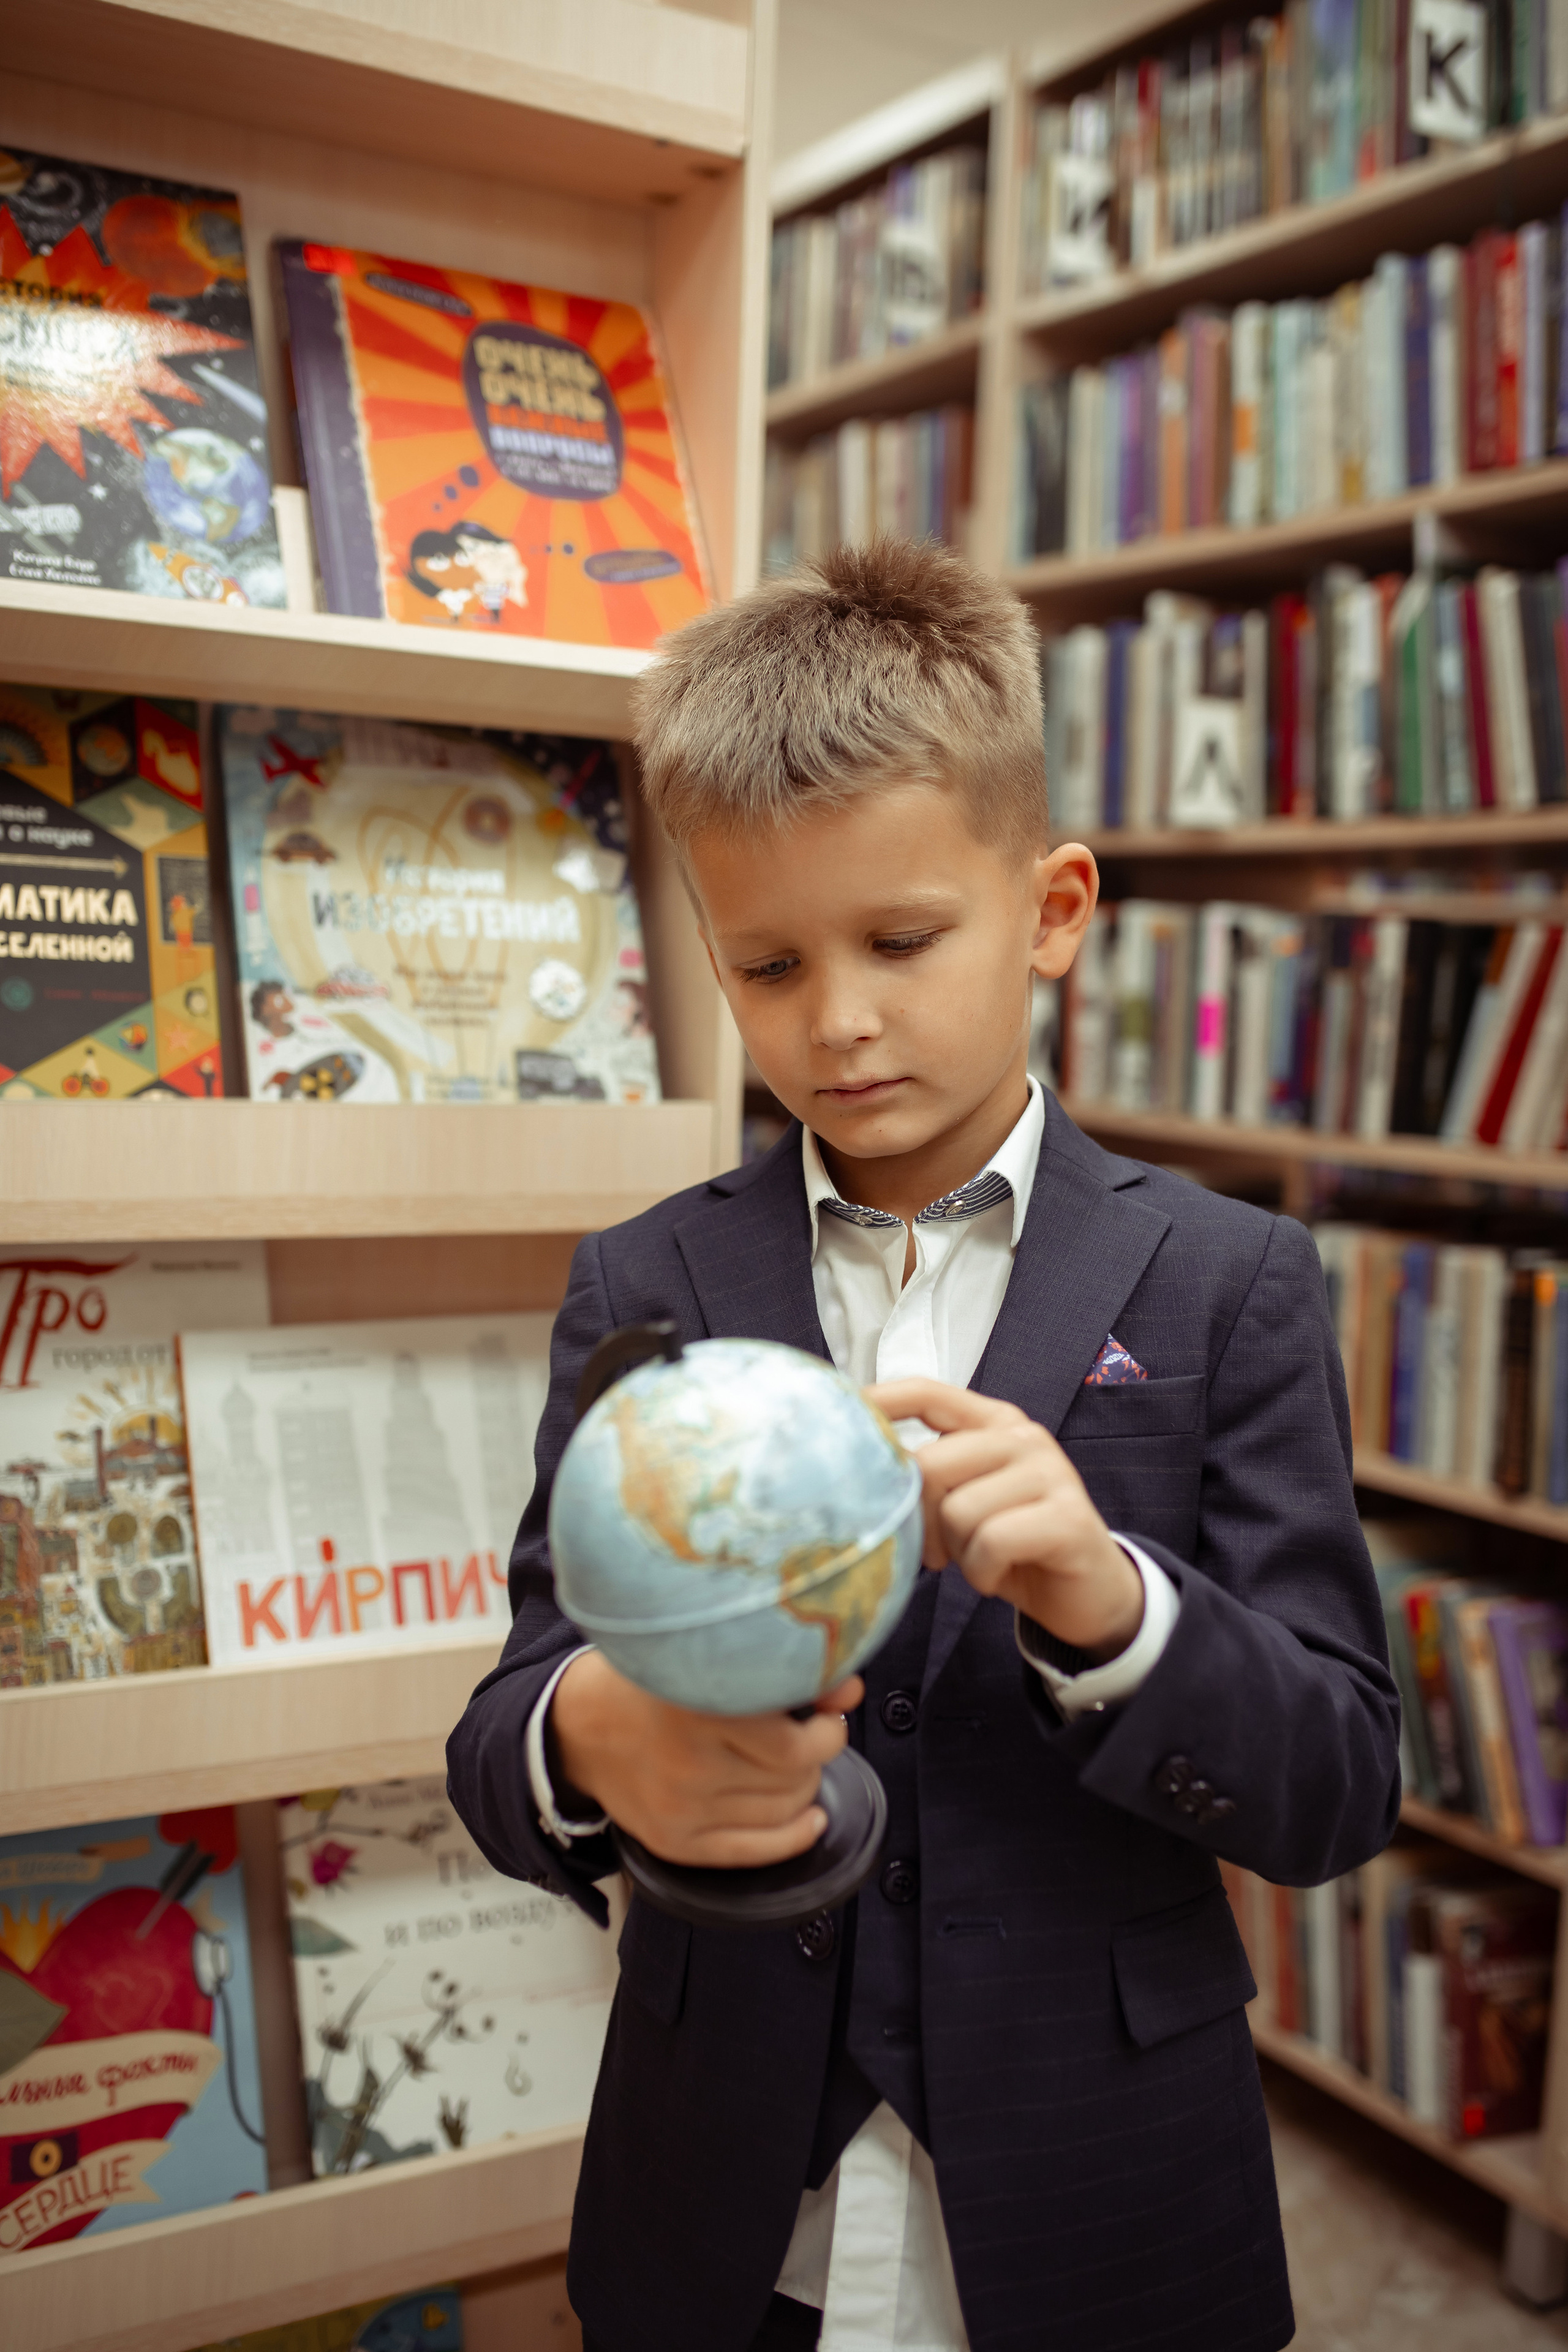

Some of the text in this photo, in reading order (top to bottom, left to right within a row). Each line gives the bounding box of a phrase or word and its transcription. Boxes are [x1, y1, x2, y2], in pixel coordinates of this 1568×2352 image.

[472, 334, 601, 391] ОЧЕНЬ
[478, 370, 607, 423] ОЧЕНЬ
[26, 825, 94, 851] науке
[0, 2153, 137, 2250] СЕРДЦЕ
